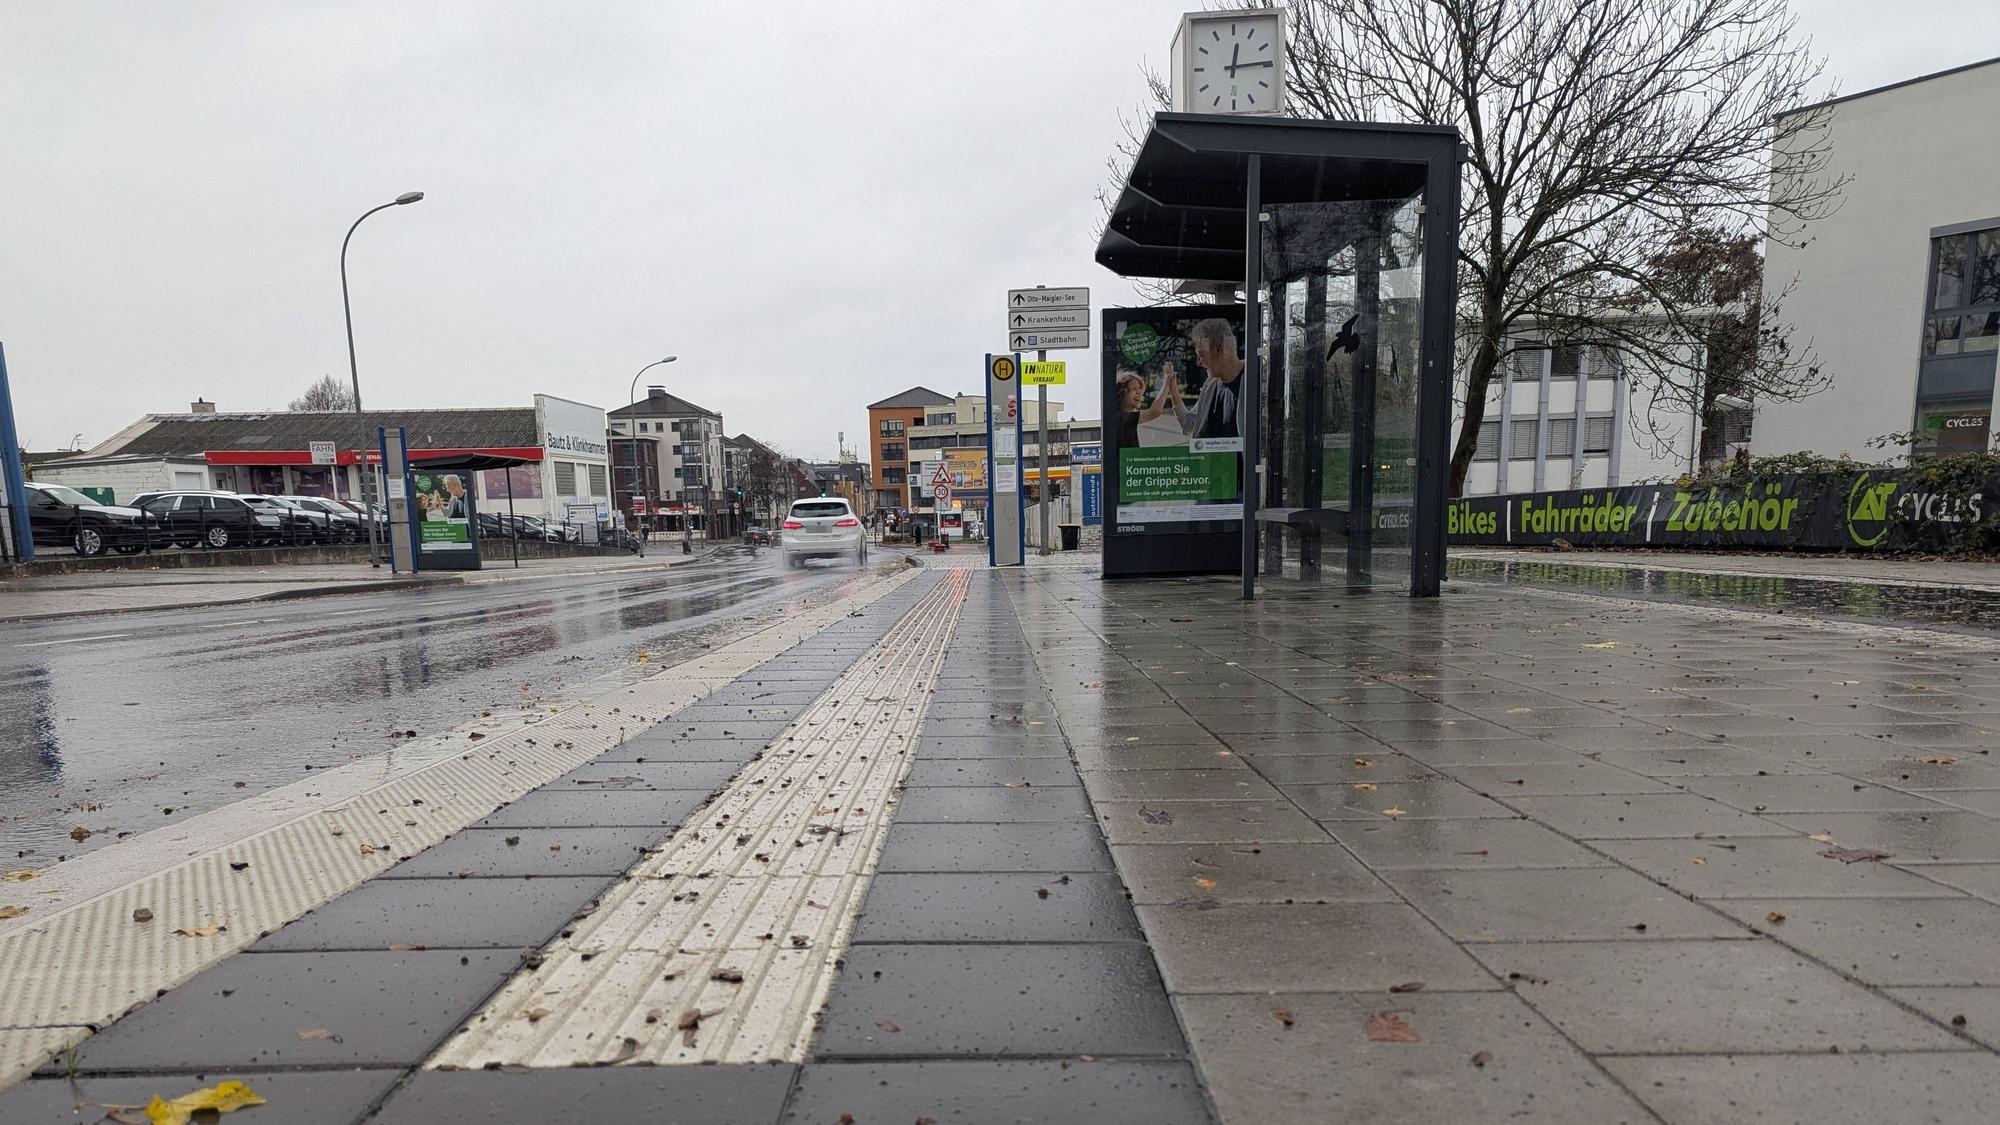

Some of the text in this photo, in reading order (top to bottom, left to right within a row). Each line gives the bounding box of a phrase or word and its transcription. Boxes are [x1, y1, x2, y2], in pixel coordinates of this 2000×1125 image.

[1027, 294, 1075, 303] Otto-Maigler-See
[1027, 315, 1076, 324] Krankenhaus
[1040, 336, 1077, 344] Stadtbahn
[999, 363, 1009, 376] H
[1024, 364, 1063, 375] INNATURA
[1946, 417, 1984, 428] CYCLES
[548, 432, 606, 455] Bautz & Klinkhammer
[1126, 465, 1190, 475] Kommen Sie
[1126, 476, 1211, 488] der Grippe zuvor.
[936, 488, 946, 496] 30
[1448, 482, 1799, 534] Bikes Fahrräder Zubehör
[1117, 525, 1145, 533] STRÖER
